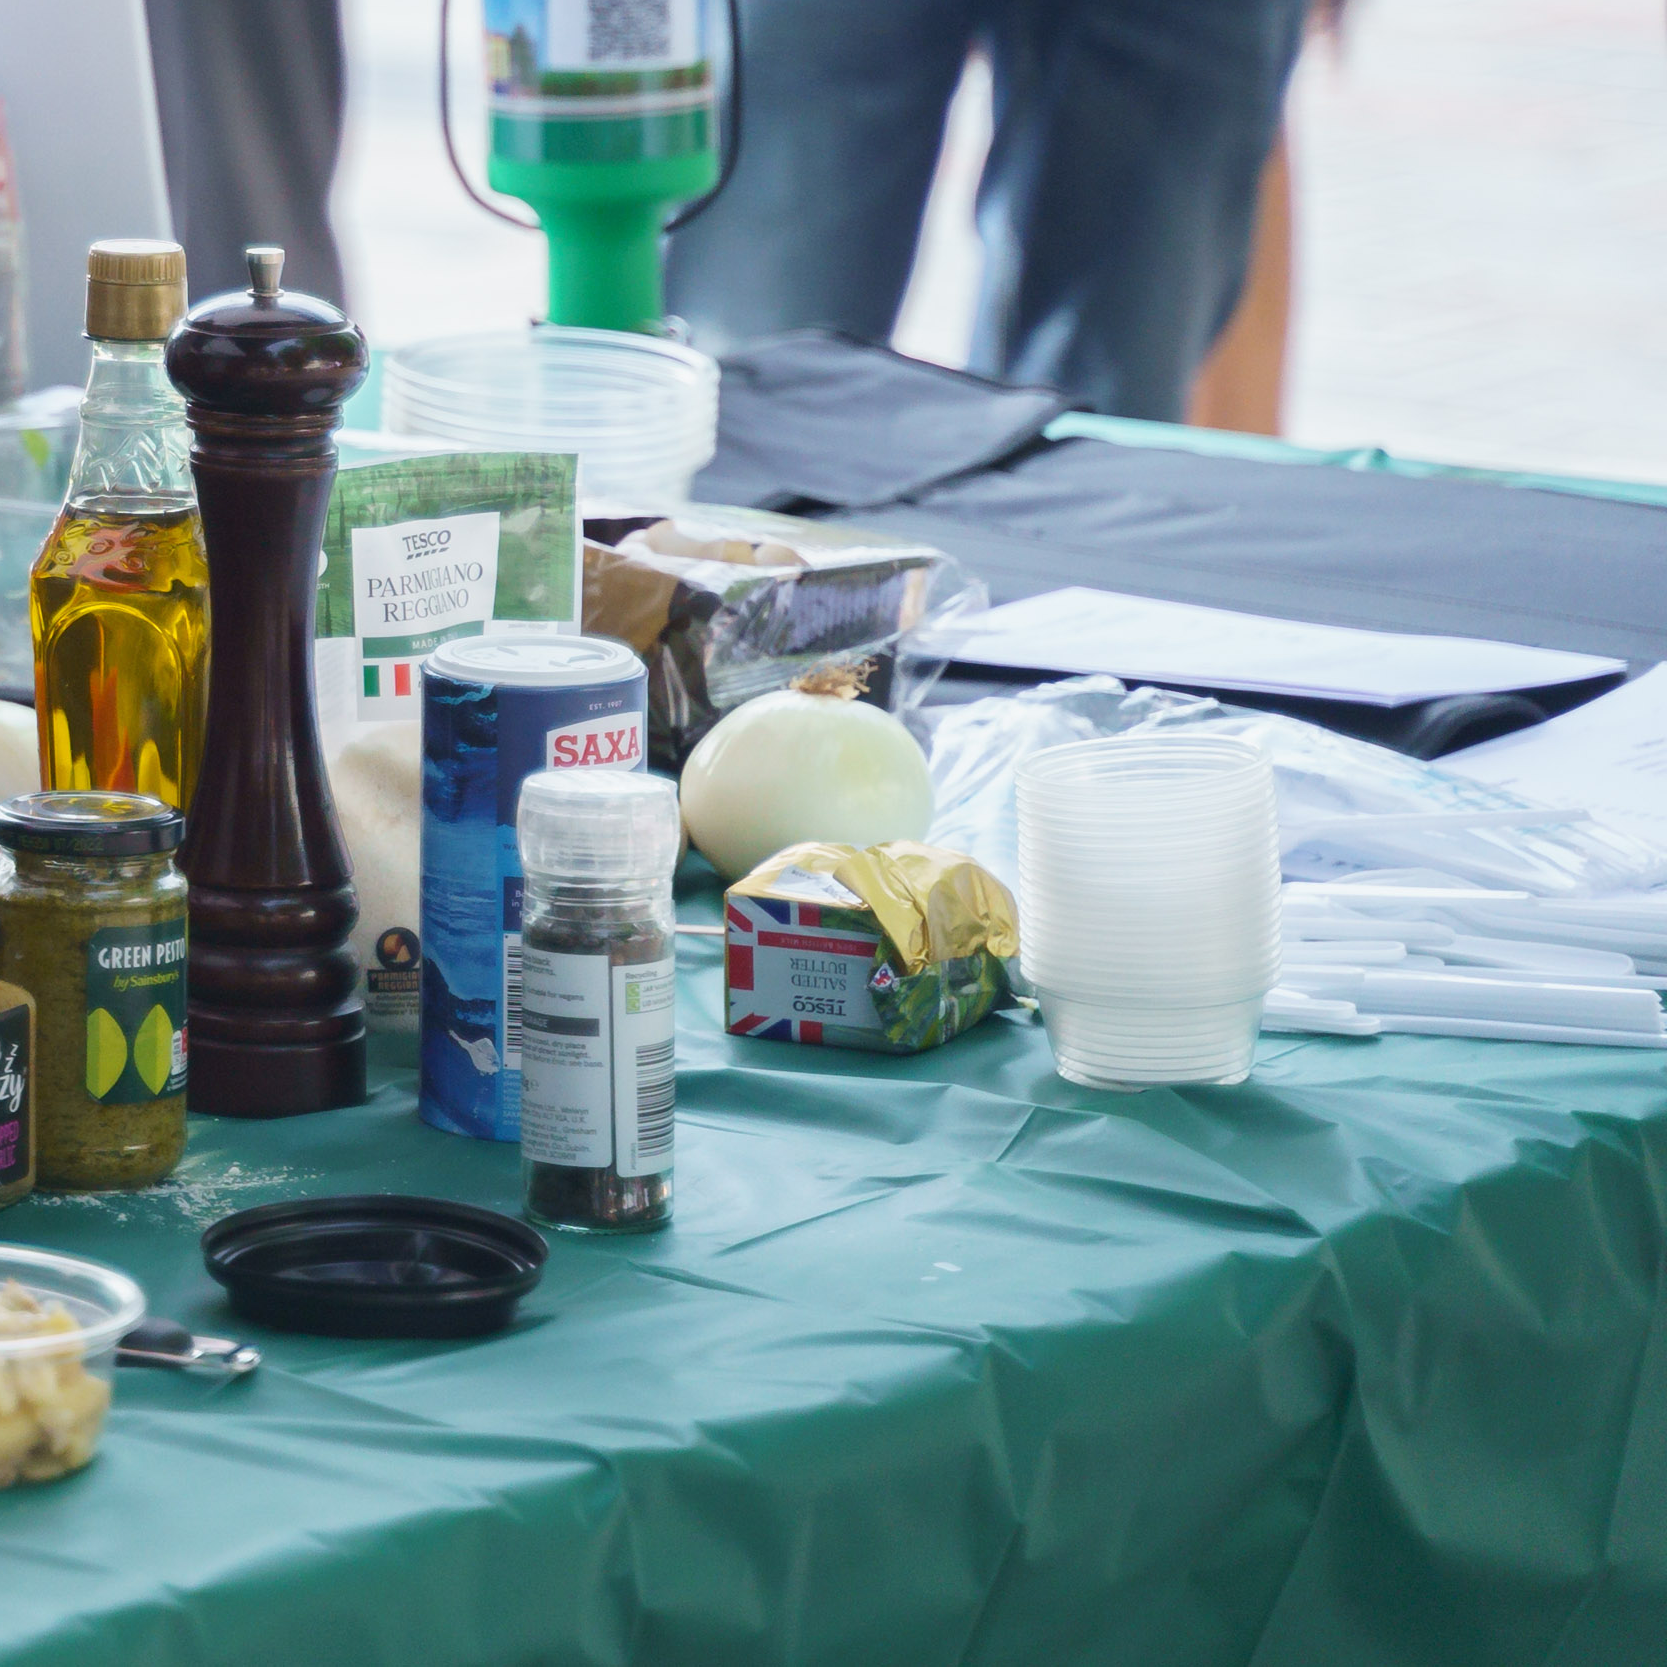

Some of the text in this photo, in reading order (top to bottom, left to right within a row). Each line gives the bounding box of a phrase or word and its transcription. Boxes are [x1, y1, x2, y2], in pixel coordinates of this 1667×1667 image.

[402, 529, 451, 552] TESCO
[367, 562, 483, 598] PARMIGIANO
[382, 588, 469, 623] REGGIANO
[412, 637, 438, 650] MADE
[589, 702, 605, 711] EST.
[553, 726, 640, 768] SAXA
[98, 937, 185, 970] GREEN PESTO
[790, 957, 847, 975] BUTTER
[113, 974, 130, 992] by
[790, 974, 847, 991] SALTED
[793, 1000, 847, 1016] TESCO
